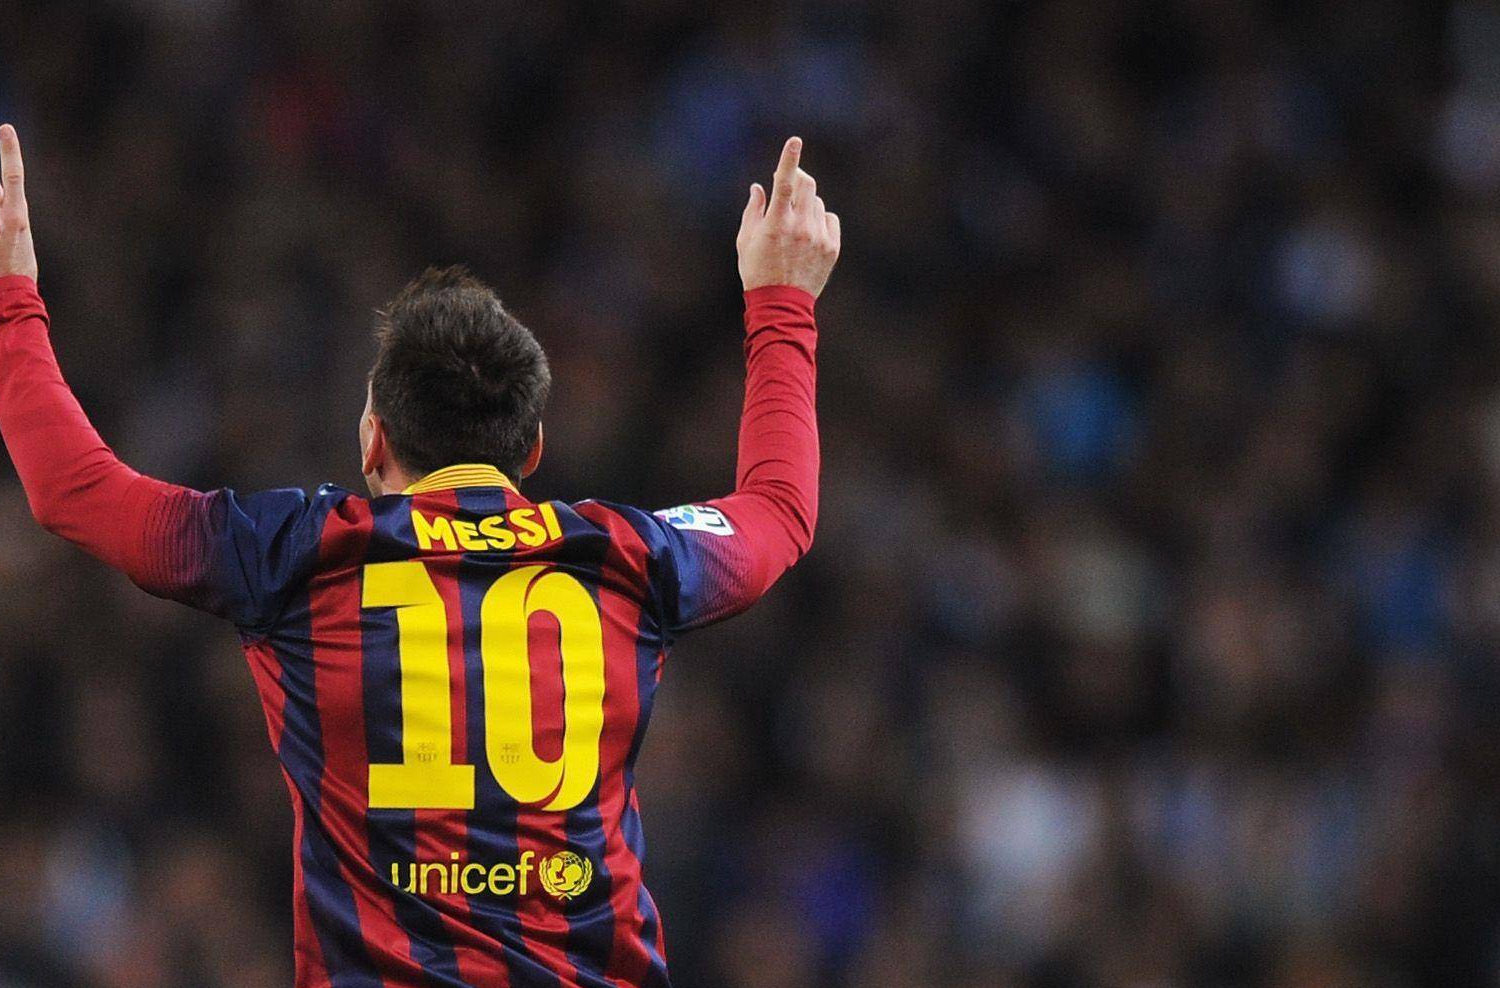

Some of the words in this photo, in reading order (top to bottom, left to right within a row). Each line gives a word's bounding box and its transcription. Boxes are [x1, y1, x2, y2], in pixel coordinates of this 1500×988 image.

[411, 503, 564, 551] MESSI
[361, 561, 605, 811] 10
[391, 851, 535, 896] unicef
